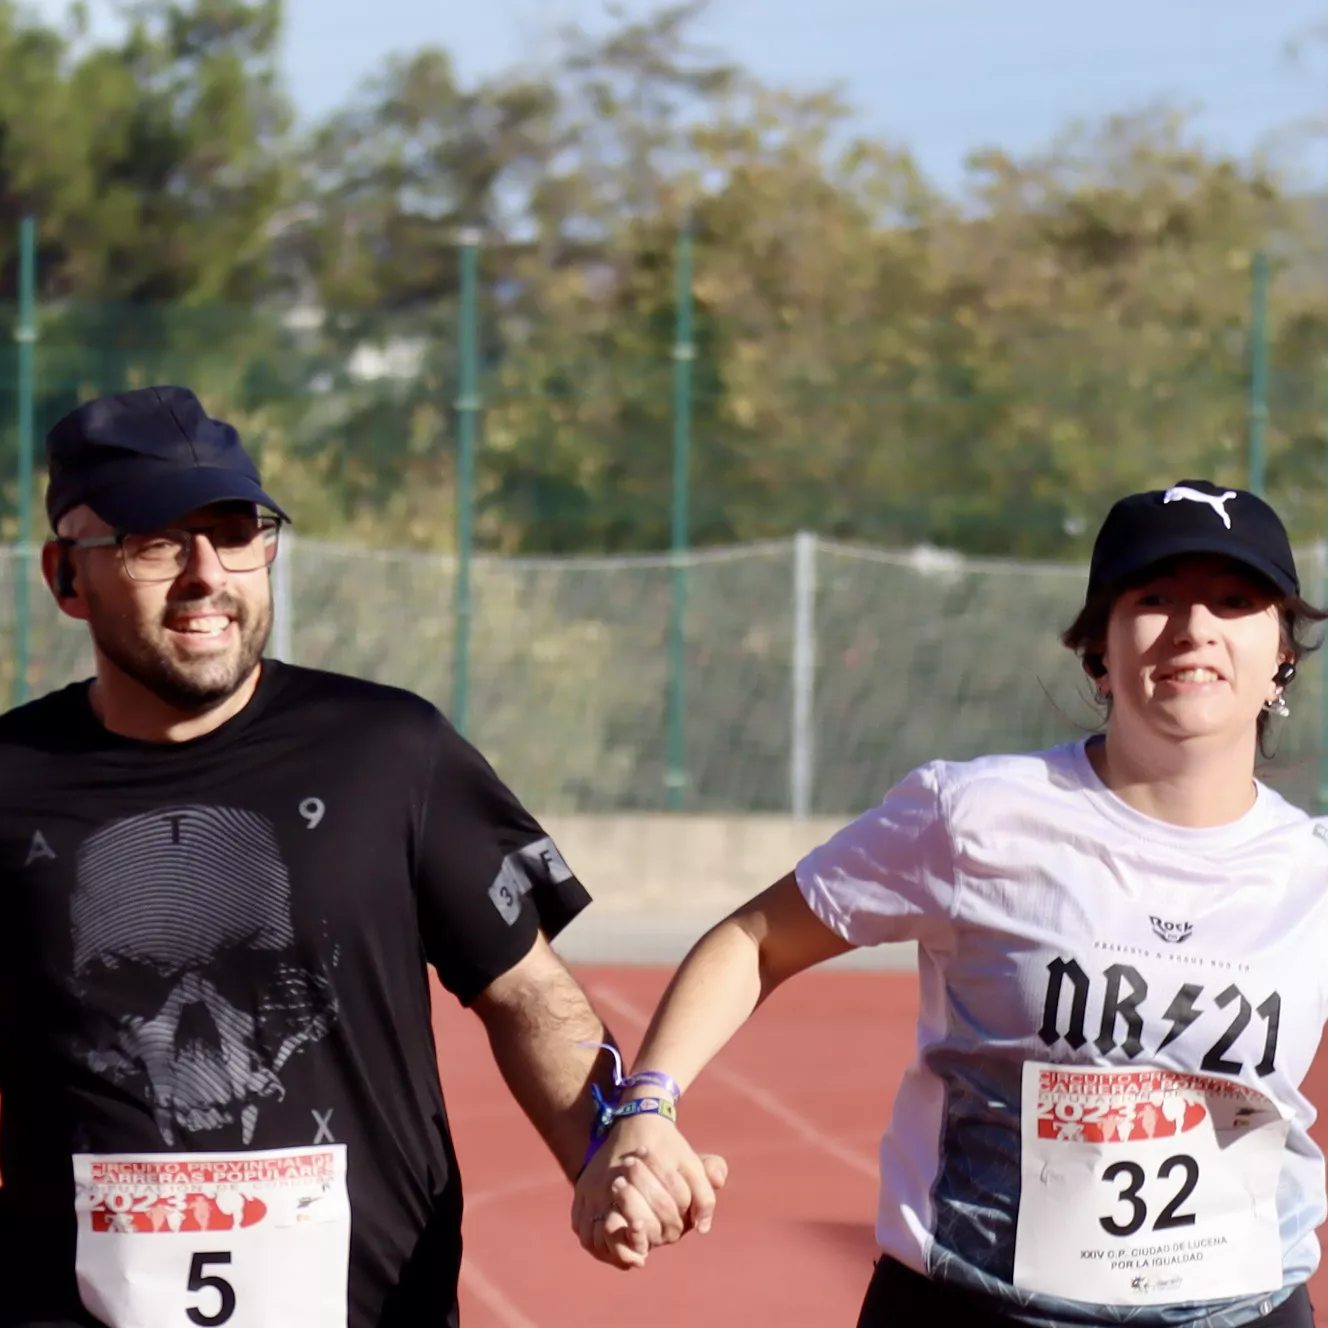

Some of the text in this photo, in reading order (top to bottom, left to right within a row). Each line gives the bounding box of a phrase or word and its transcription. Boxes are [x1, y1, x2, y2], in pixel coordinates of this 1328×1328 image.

[298, 796, 326, 830] 9
[24, 829, 58, 867] A
[1039, 1081, 1153, 1095] CARRERAS
[310, 1107, 335, 1144] X
[187, 1156, 303, 1173] PROVINCIAL
[1098, 1153, 1200, 1238] 32
[1110, 1252, 1204, 1271] POR LA IGUALDAD
[1131, 1246, 1171, 1257] CIUDAD
[1173, 1242, 1186, 1252] DE
[1188, 1236, 1228, 1250] LUCENA
[185, 1250, 237, 1328] 5
